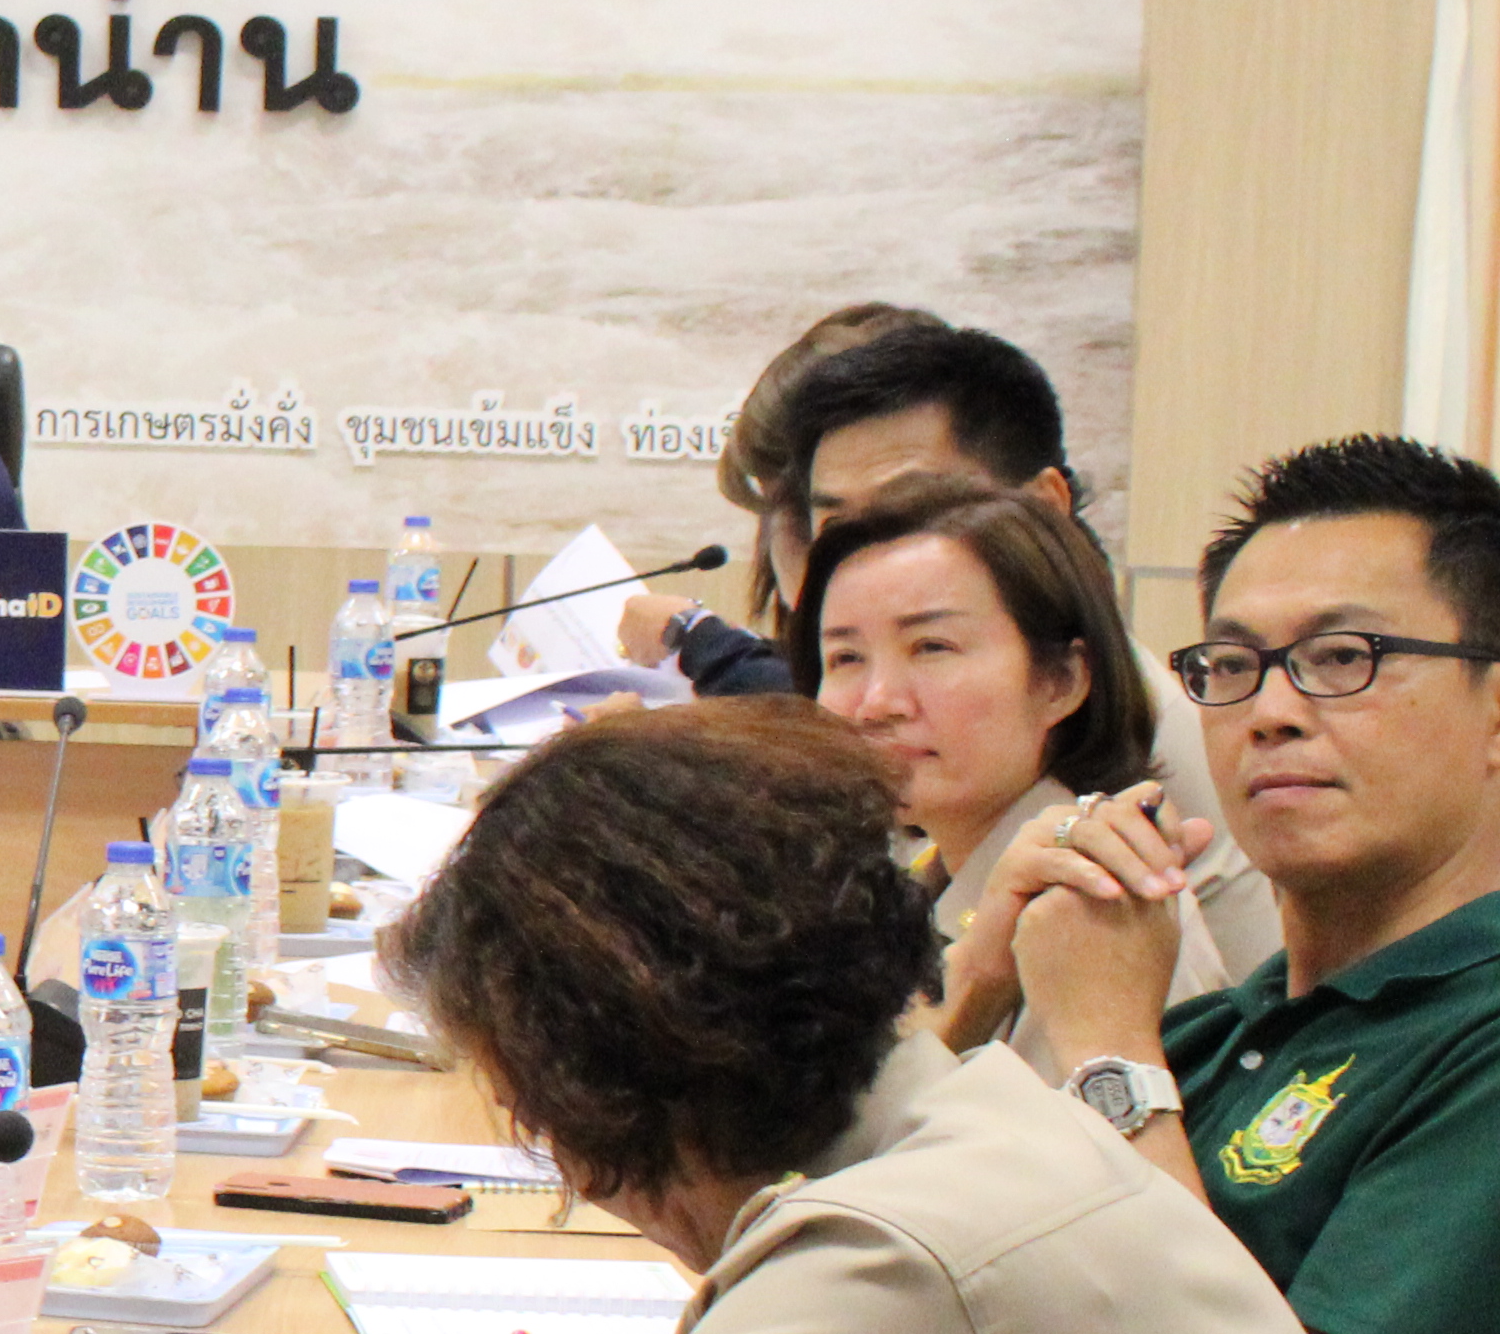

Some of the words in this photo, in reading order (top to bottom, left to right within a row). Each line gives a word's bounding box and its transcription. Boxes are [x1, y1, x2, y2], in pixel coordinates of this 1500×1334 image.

[36, 389, 315, 445] การเกษตรมั่งคั่ง
[345, 402, 596, 457] ชุมชนเข้มแข็ง
